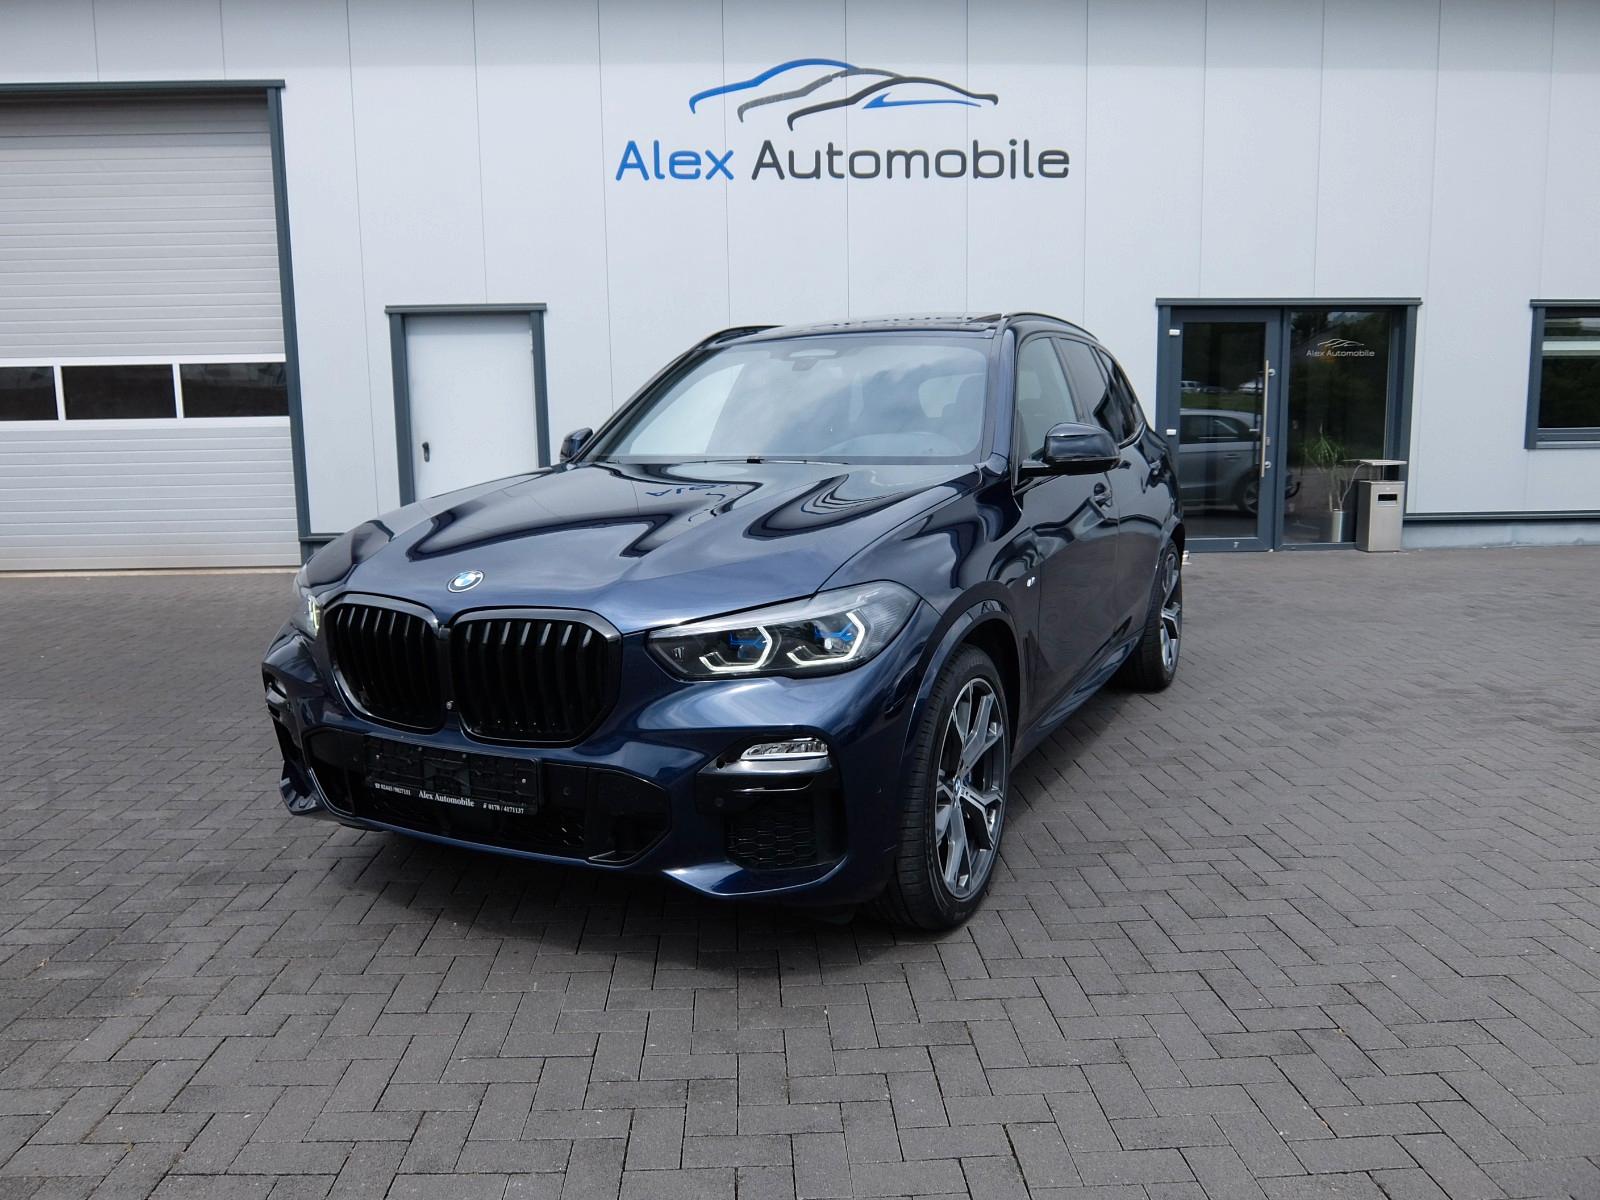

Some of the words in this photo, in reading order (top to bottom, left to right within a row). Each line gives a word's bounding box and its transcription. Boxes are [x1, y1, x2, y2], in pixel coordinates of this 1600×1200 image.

[615, 139, 735, 181] Alex
[751, 138, 1071, 181] Automobile
[418, 789, 433, 799] Alex
[434, 793, 475, 807] Automobile
